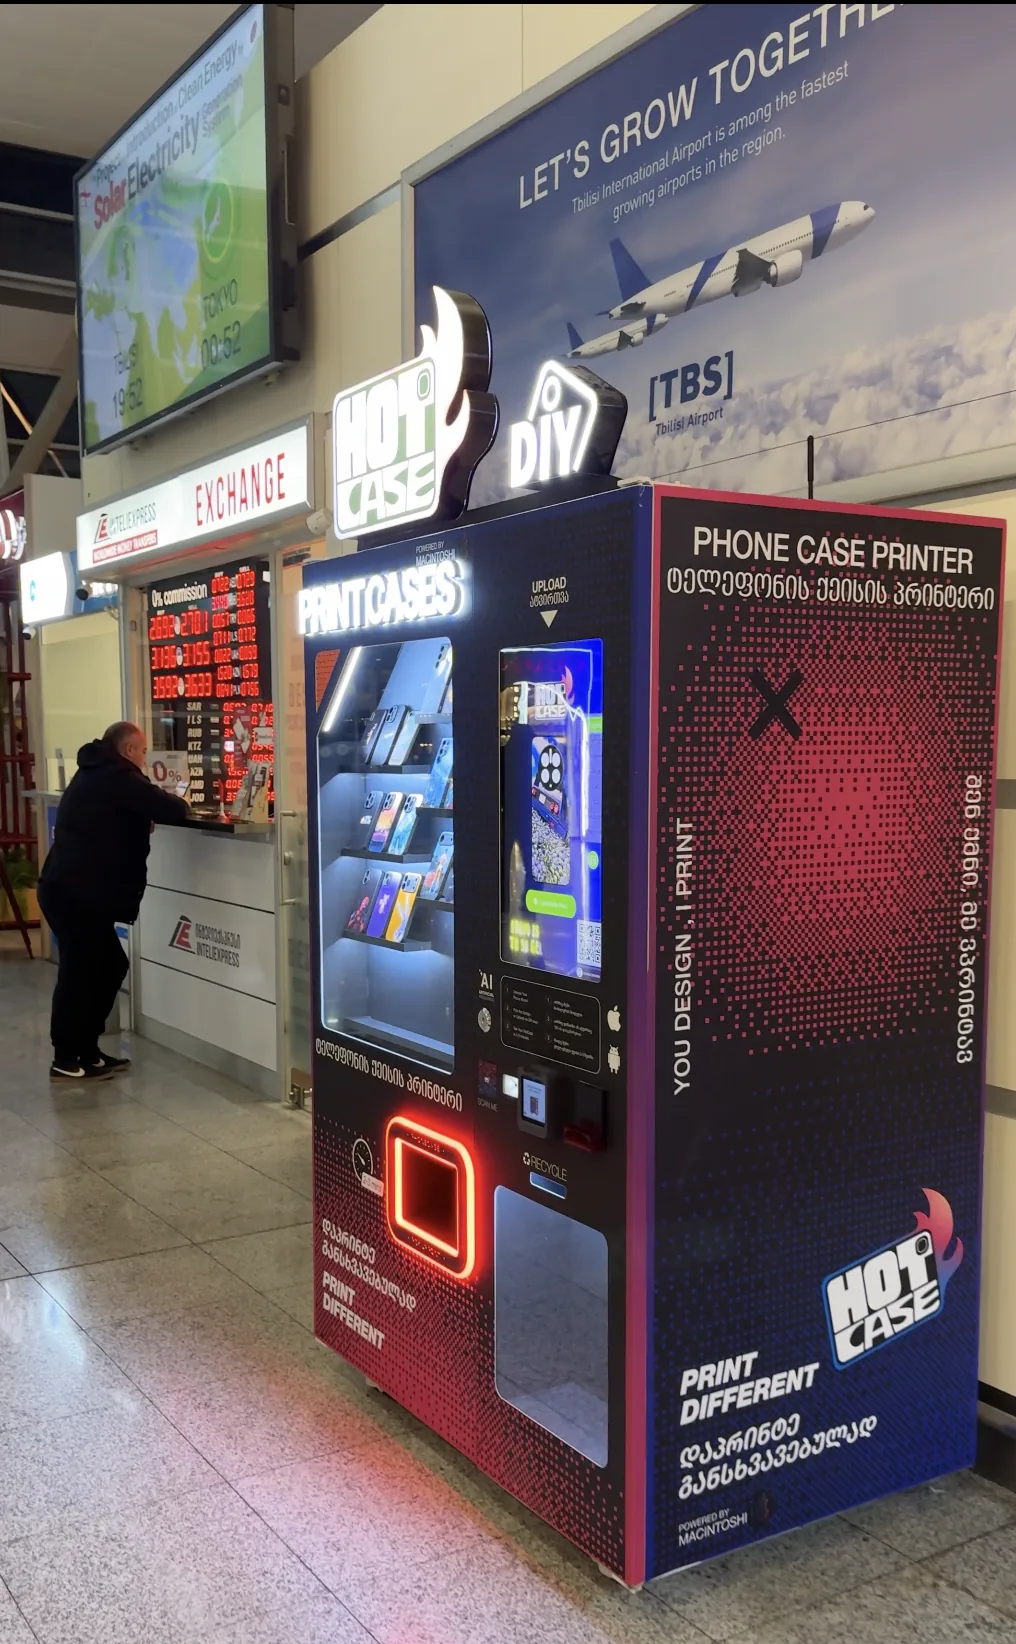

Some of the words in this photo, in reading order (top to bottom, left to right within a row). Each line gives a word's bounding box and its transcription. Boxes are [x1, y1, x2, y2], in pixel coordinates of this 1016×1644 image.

[178, 73, 203, 110] Clean
[204, 40, 237, 86] Energy
[127, 111, 200, 200] Electricity
[519, 140, 590, 209] LET'S
[599, 76, 698, 163] GROW
[571, 187, 600, 214] Tbilisi
[602, 154, 669, 200] International
[672, 131, 712, 166] Airport
[715, 125, 726, 142] is
[728, 99, 772, 137] among
[775, 86, 797, 113] the
[801, 60, 849, 99] fastest
[612, 189, 655, 223] growing
[657, 164, 702, 202] airports
[705, 157, 717, 175] in
[719, 145, 739, 171] the
[741, 126, 786, 158] region.
[202, 278, 238, 323] TOKYO
[200, 320, 241, 372] 00:52
[336, 362, 436, 482] HOT
[510, 404, 582, 488] DIY
[656, 418, 685, 436] Tbilisi
[687, 406, 724, 428] Airport
[195, 452, 286, 527] EXCHANGE
[337, 452, 436, 530] CASE
[416, 542, 437, 554] POWERED
[438, 540, 445, 549] BY
[693, 526, 790, 563] PHONE
[797, 534, 866, 568] CASE
[872, 541, 973, 575] PRINTER
[152, 589, 163, 607] 0%
[163, 581, 208, 606] commission
[298, 577, 366, 636] PRINT
[365, 558, 465, 626] CASES
[532, 577, 567, 593] UPLOAD
[667, 567, 810, 602] ტელეფონის
[816, 577, 887, 605] ქეისის
[893, 581, 995, 611] პრინტერი
[187, 702, 202, 711] SAR
[187, 715, 202, 725] ILS
[187, 728, 203, 738] RUB
[964, 774, 983, 820] შენ
[675, 817, 694, 897] PRINT
[959, 901, 978, 931] მე
[480, 972, 493, 990] AI
[956, 938, 977, 1065] ვპრინტავ
[674, 1039, 692, 1096] YOU
[531, 1155, 568, 1182] RECYCLE
[322, 1218, 376, 1265] დაპრინტე
[322, 1270, 355, 1306] PRINT
[827, 1231, 933, 1334] HOT
[322, 1292, 385, 1351] DIFFERENT
[834, 1279, 940, 1364] CASE
[680, 1351, 758, 1395] PRINT
[680, 1362, 820, 1426] DIFFERENT
[678, 1415, 878, 1500] განსხვავებულად
[680, 1412, 801, 1469] დაპრინტე
[678, 1511, 717, 1533] POWERED
[719, 1507, 730, 1519] BY
[678, 1512, 748, 1547] MACINTOSHI
